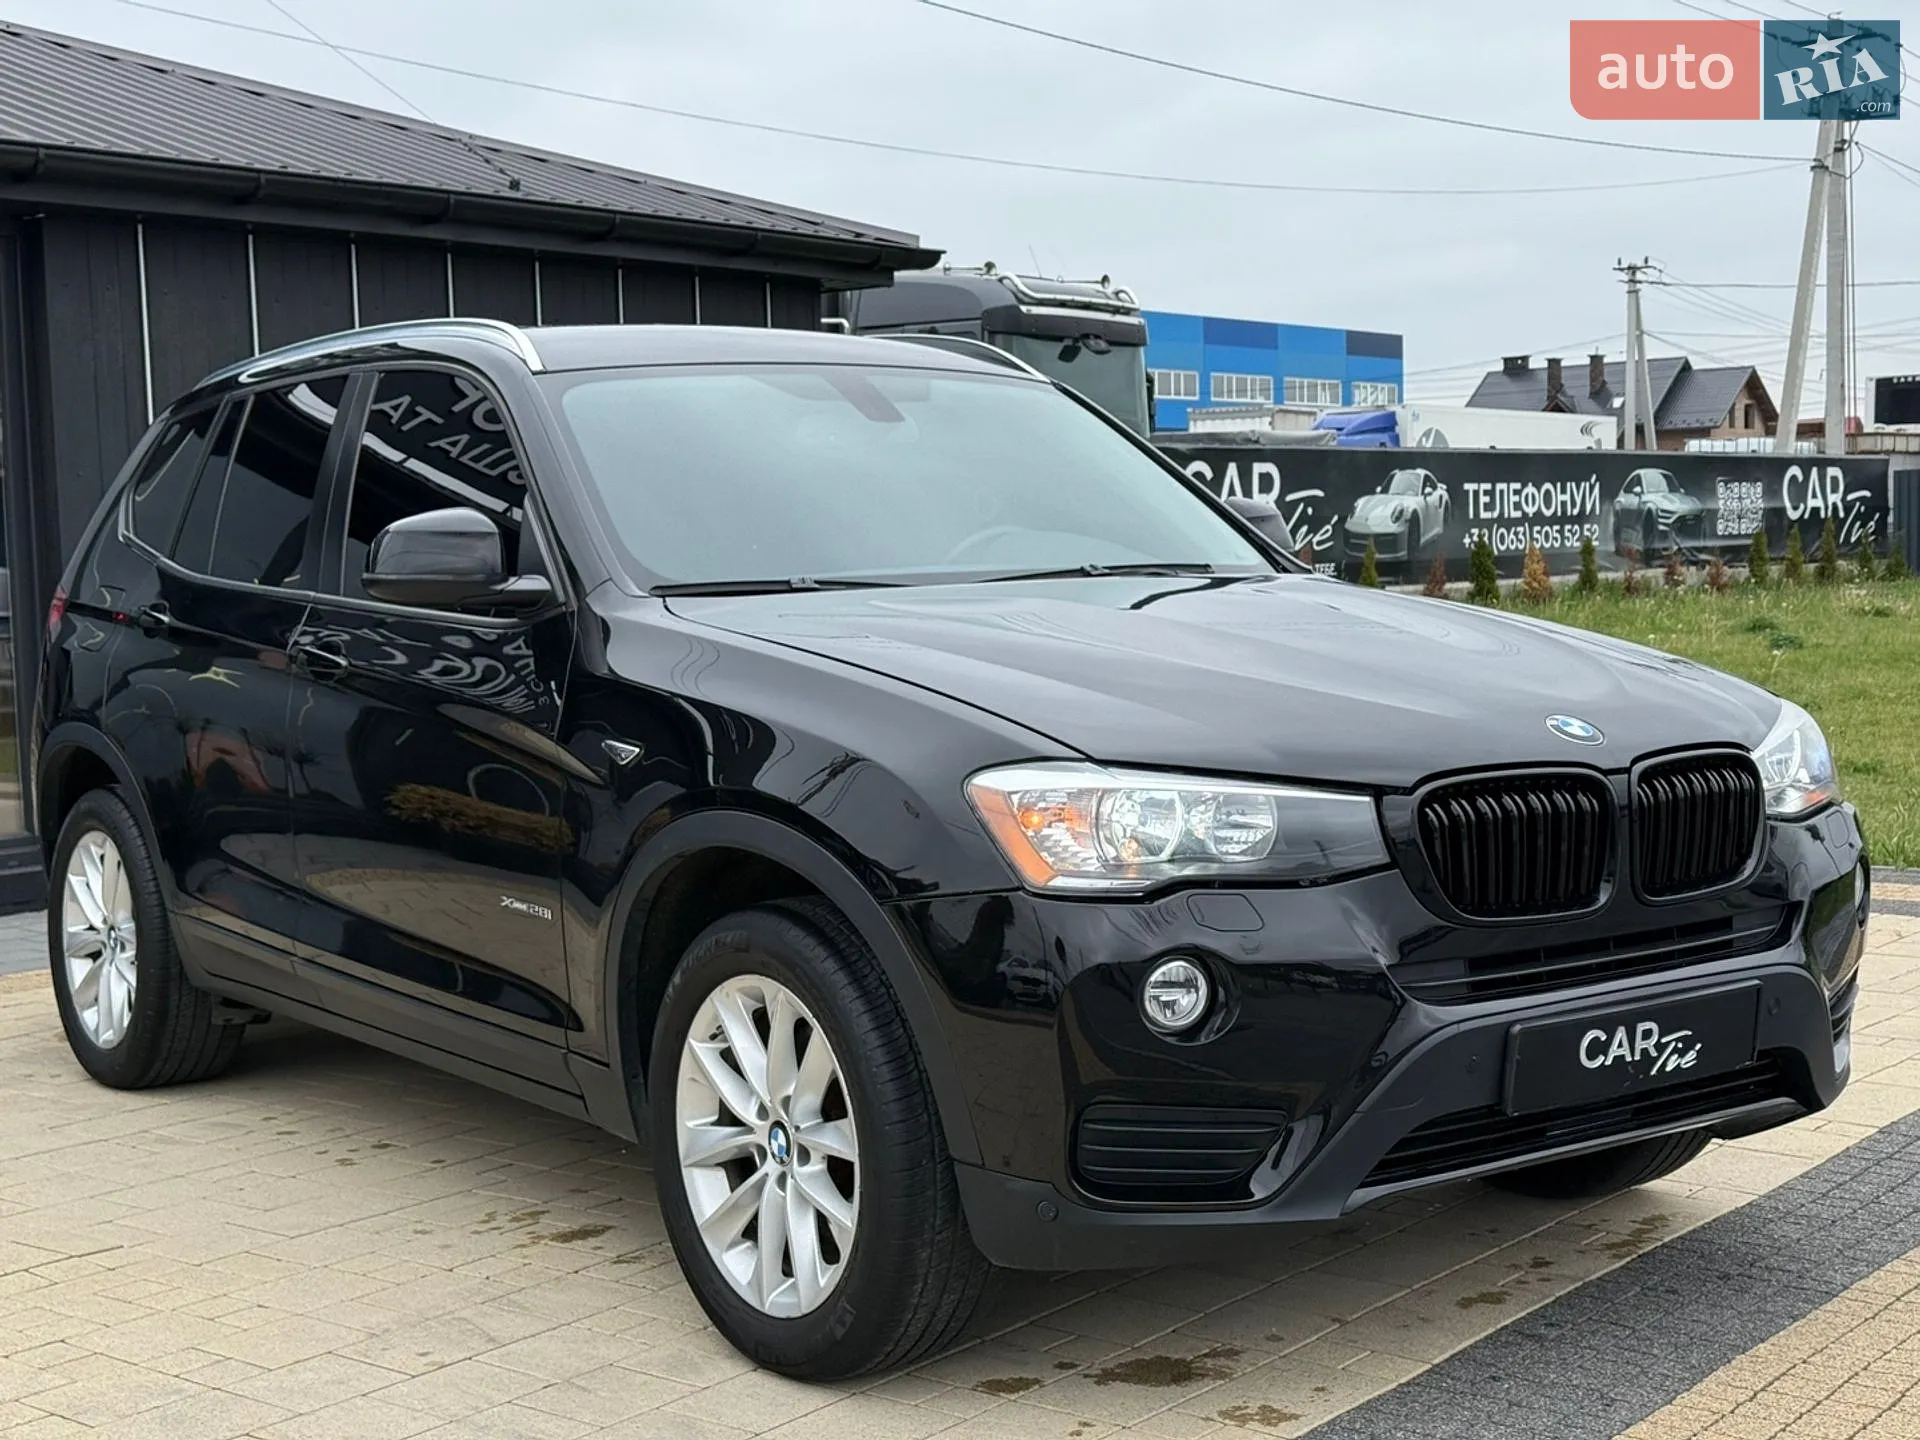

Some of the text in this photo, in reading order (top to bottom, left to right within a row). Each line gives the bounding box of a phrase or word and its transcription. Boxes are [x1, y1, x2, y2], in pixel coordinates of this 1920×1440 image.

[1463, 473, 1600, 519] ТЕЛЕФОНУЙ
[1782, 464, 1845, 521] CAR
[1492, 522, 1530, 555] (063)
[1533, 525, 1561, 549] 505
[1564, 524, 1580, 548] 52
[1579, 1021, 1659, 1070] CAR
